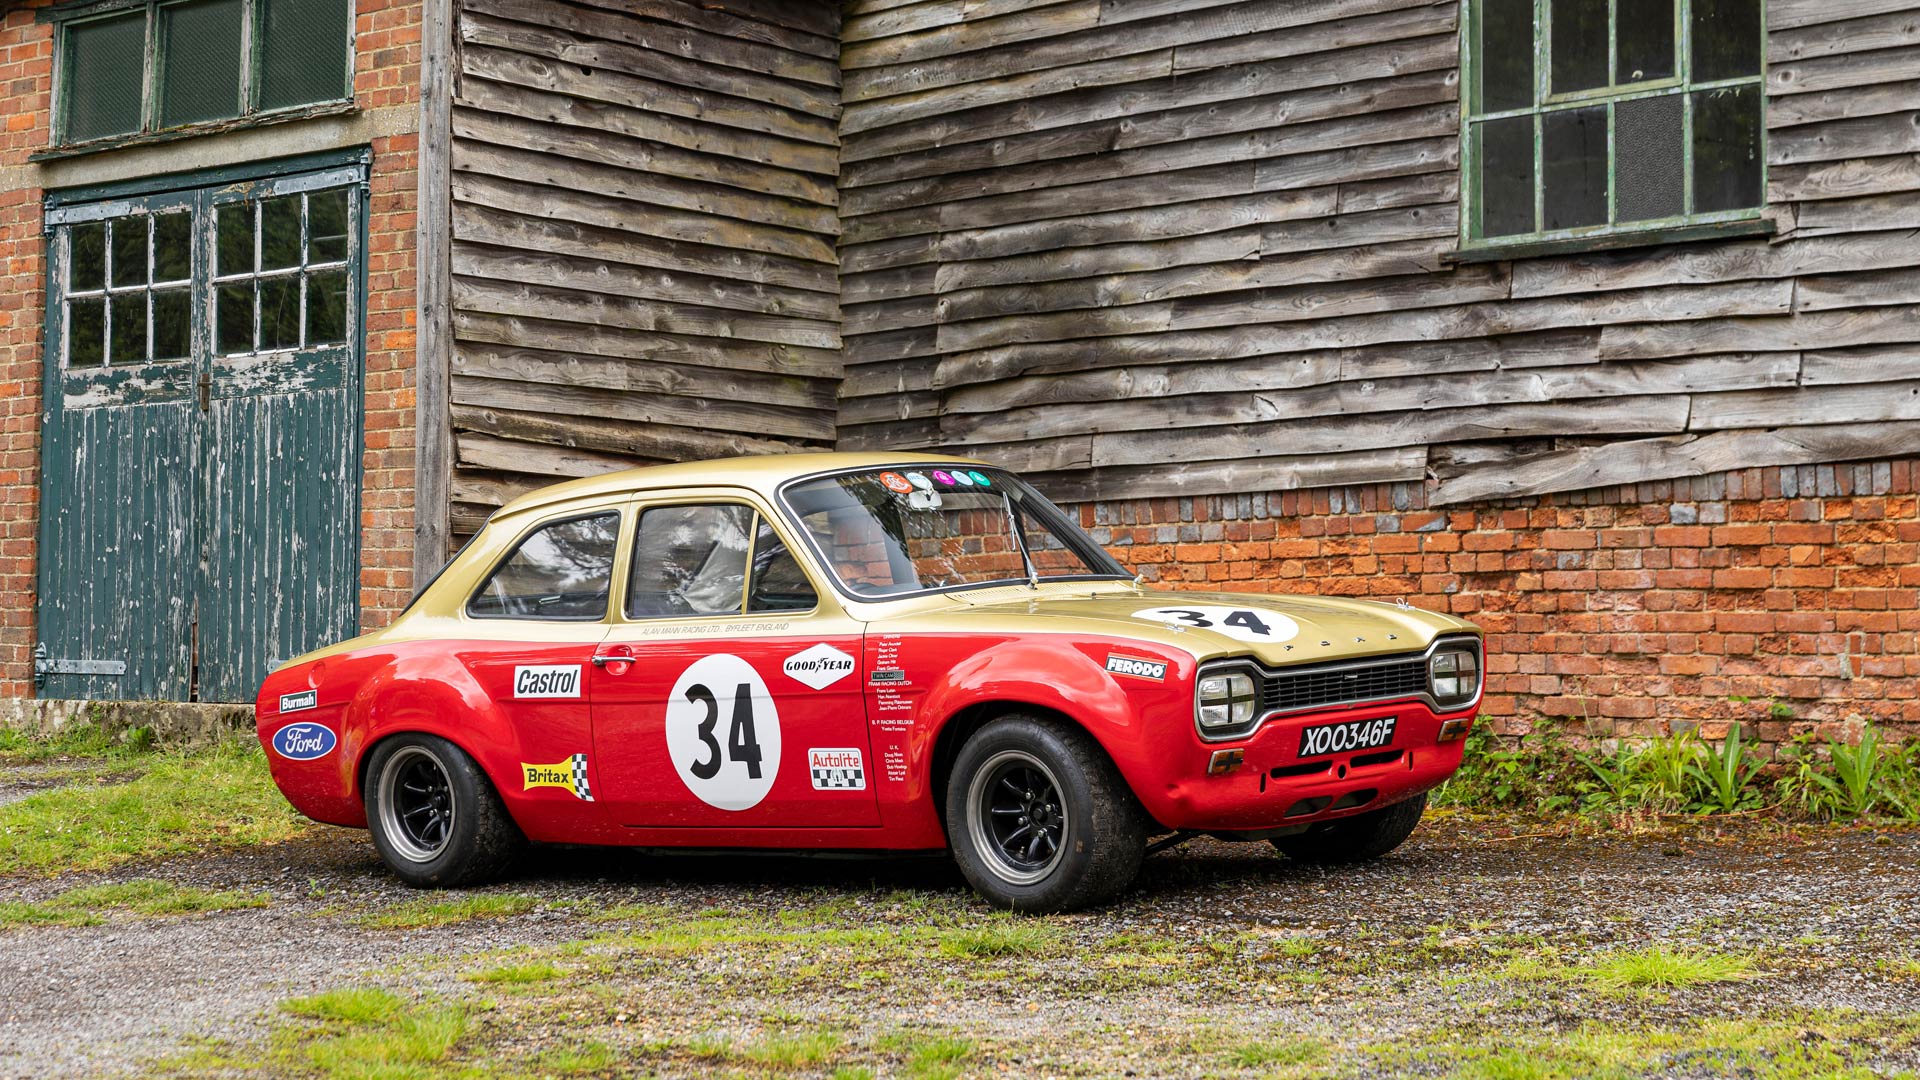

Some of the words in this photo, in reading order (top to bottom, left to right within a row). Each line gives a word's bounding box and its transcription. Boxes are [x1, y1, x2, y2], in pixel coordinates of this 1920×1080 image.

[641, 627, 660, 635] ALAN
[660, 626, 681, 634] MANN
[682, 625, 706, 633] RACING
[724, 623, 756, 632] BYFLEET
[756, 622, 790, 631] ENGLAND
[1157, 610, 1271, 636] 34
[1107, 657, 1164, 678] FERODO
[517, 669, 578, 694] Castrol
[282, 693, 315, 710] Burmah
[285, 727, 324, 754] Ford
[684, 682, 763, 780] 34
[1301, 718, 1395, 756] XOO346F
[813, 752, 860, 768] Autolite
[527, 768, 569, 784] Britax
